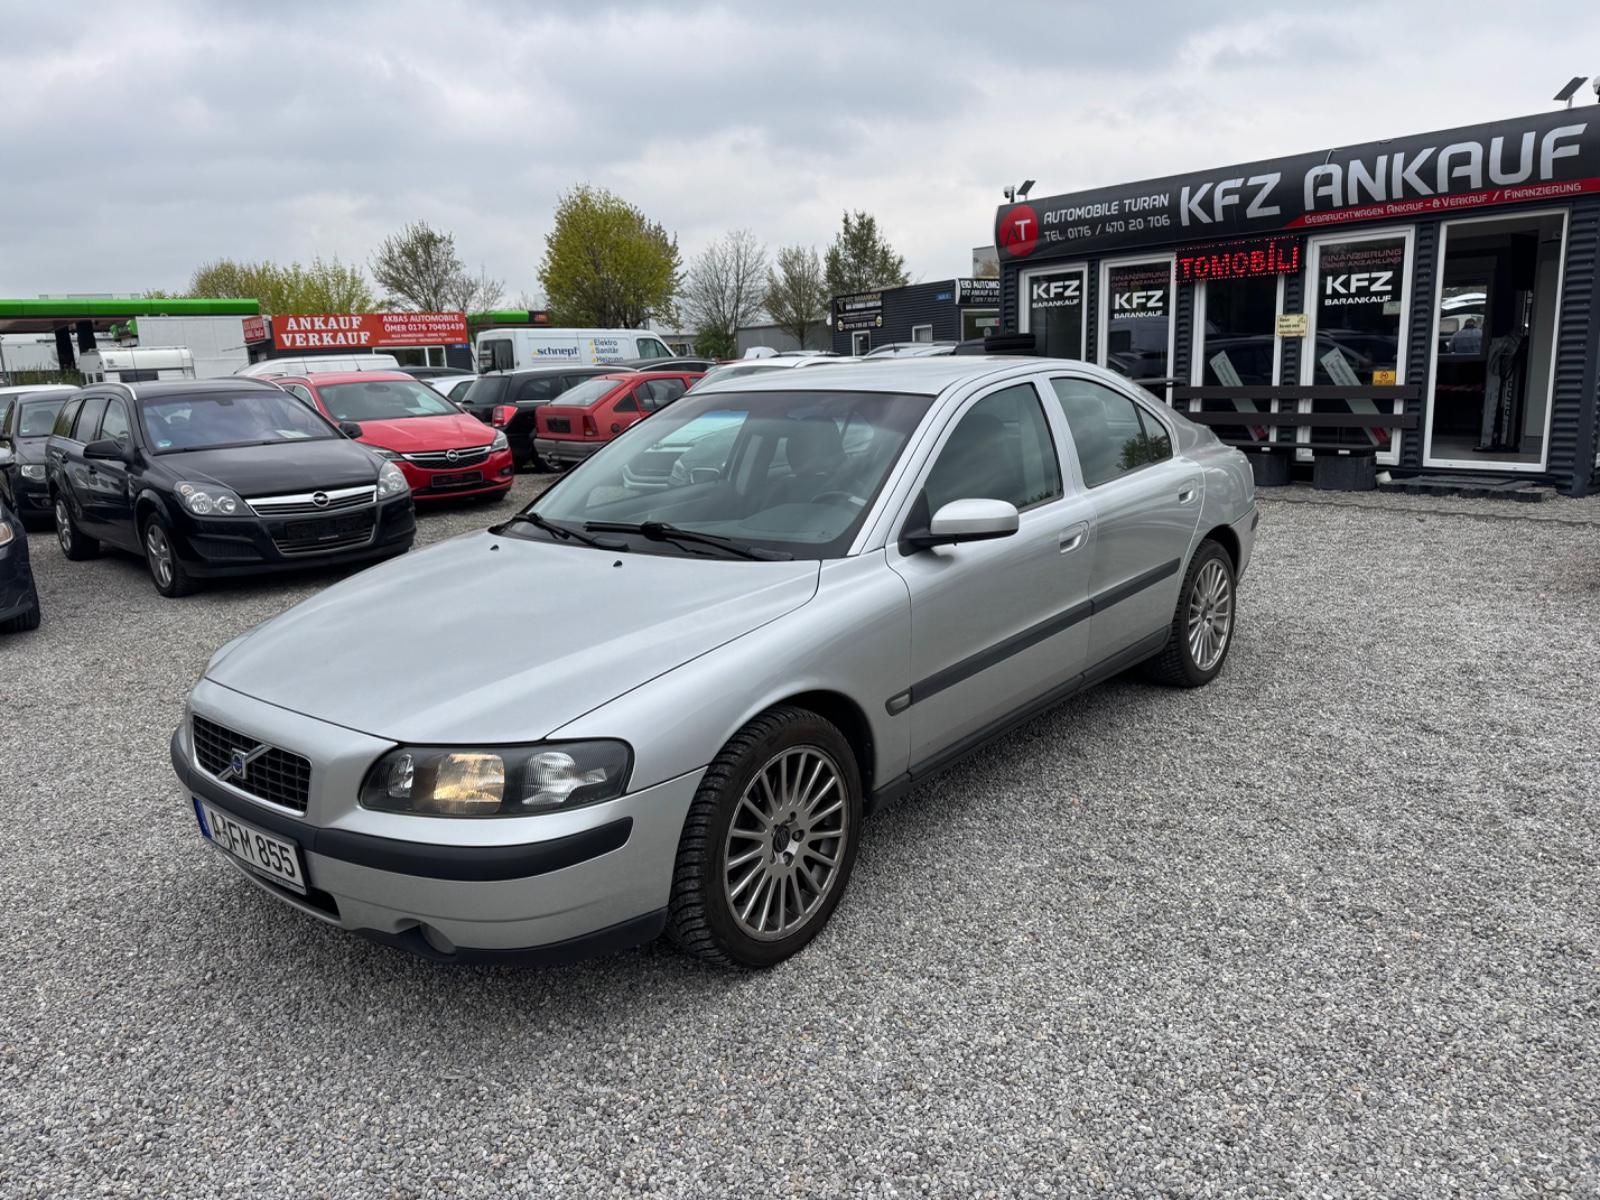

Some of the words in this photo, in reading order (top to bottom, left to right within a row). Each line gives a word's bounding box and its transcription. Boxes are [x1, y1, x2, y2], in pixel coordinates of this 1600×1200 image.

[1180, 172, 1282, 226] KFZ
[1303, 123, 1588, 211] ANKAUF
[1043, 202, 1119, 225] AUTOMOBILE
[1123, 192, 1169, 212] TURAN
[1386, 202, 1424, 214] ANKAUF
[1441, 193, 1488, 208] VERKAUF
[1492, 190, 1500, 202] /
[1504, 183, 1582, 201] FINANZIERUNG
[1044, 229, 1066, 242] TEL.
[1067, 225, 1092, 240] 0176
[1095, 225, 1102, 237] /
[1105, 219, 1125, 234] 470
[1128, 217, 1145, 232] 20
[1149, 214, 1171, 229] 706
[1032, 279, 1080, 300] KFZ
[1326, 271, 1393, 295] KFZ
[1032, 298, 1080, 309] BARANKAUF
[1114, 290, 1164, 310] KFZ
[1324, 295, 1392, 306] BARANKAUF
[286, 316, 363, 331] ANKAUF
[383, 314, 408, 323] AKBAS
[410, 313, 459, 322] AUTOMOBILE
[1114, 310, 1163, 320] BARANKAUF
[384, 323, 407, 332] ÖMER
[408, 323, 427, 331] 0176
[280, 331, 370, 347] VERKAUF
[227, 821, 255, 861] FM
[255, 834, 296, 878] 855
